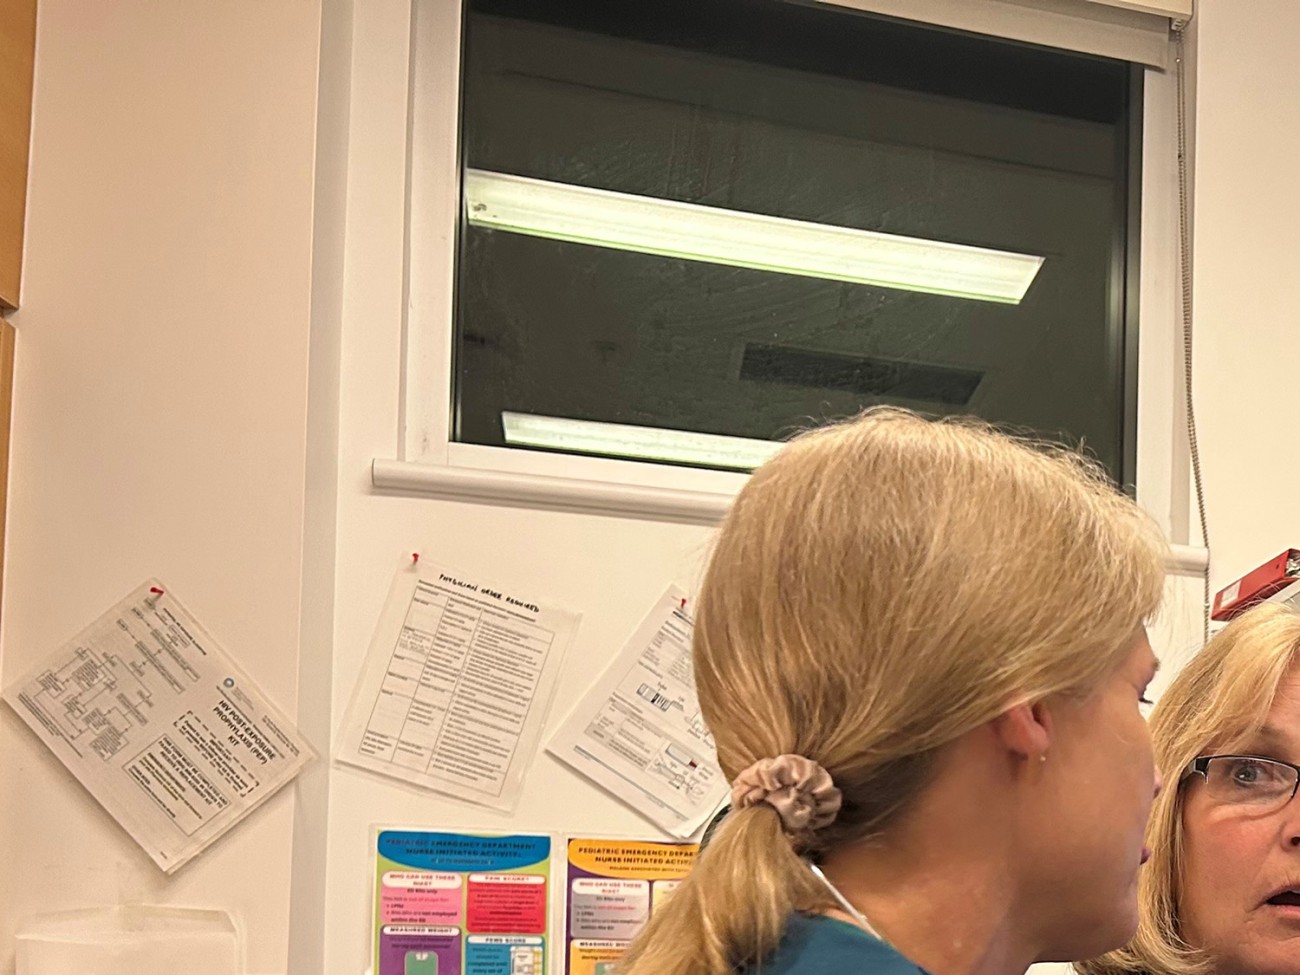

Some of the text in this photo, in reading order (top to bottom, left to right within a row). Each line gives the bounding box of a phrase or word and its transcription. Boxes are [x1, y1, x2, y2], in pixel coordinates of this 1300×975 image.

[213, 706, 267, 765] PROPHYLAXIS (PEP)
[218, 700, 276, 760] HIV POST-EXPOSURE
[228, 735, 240, 746] KIT
[386, 838, 535, 849] PEDIATRIC EMERGENCY DEPARTMENT
[578, 846, 694, 857] PEDIATRIC EMERGENCY DEPAR
